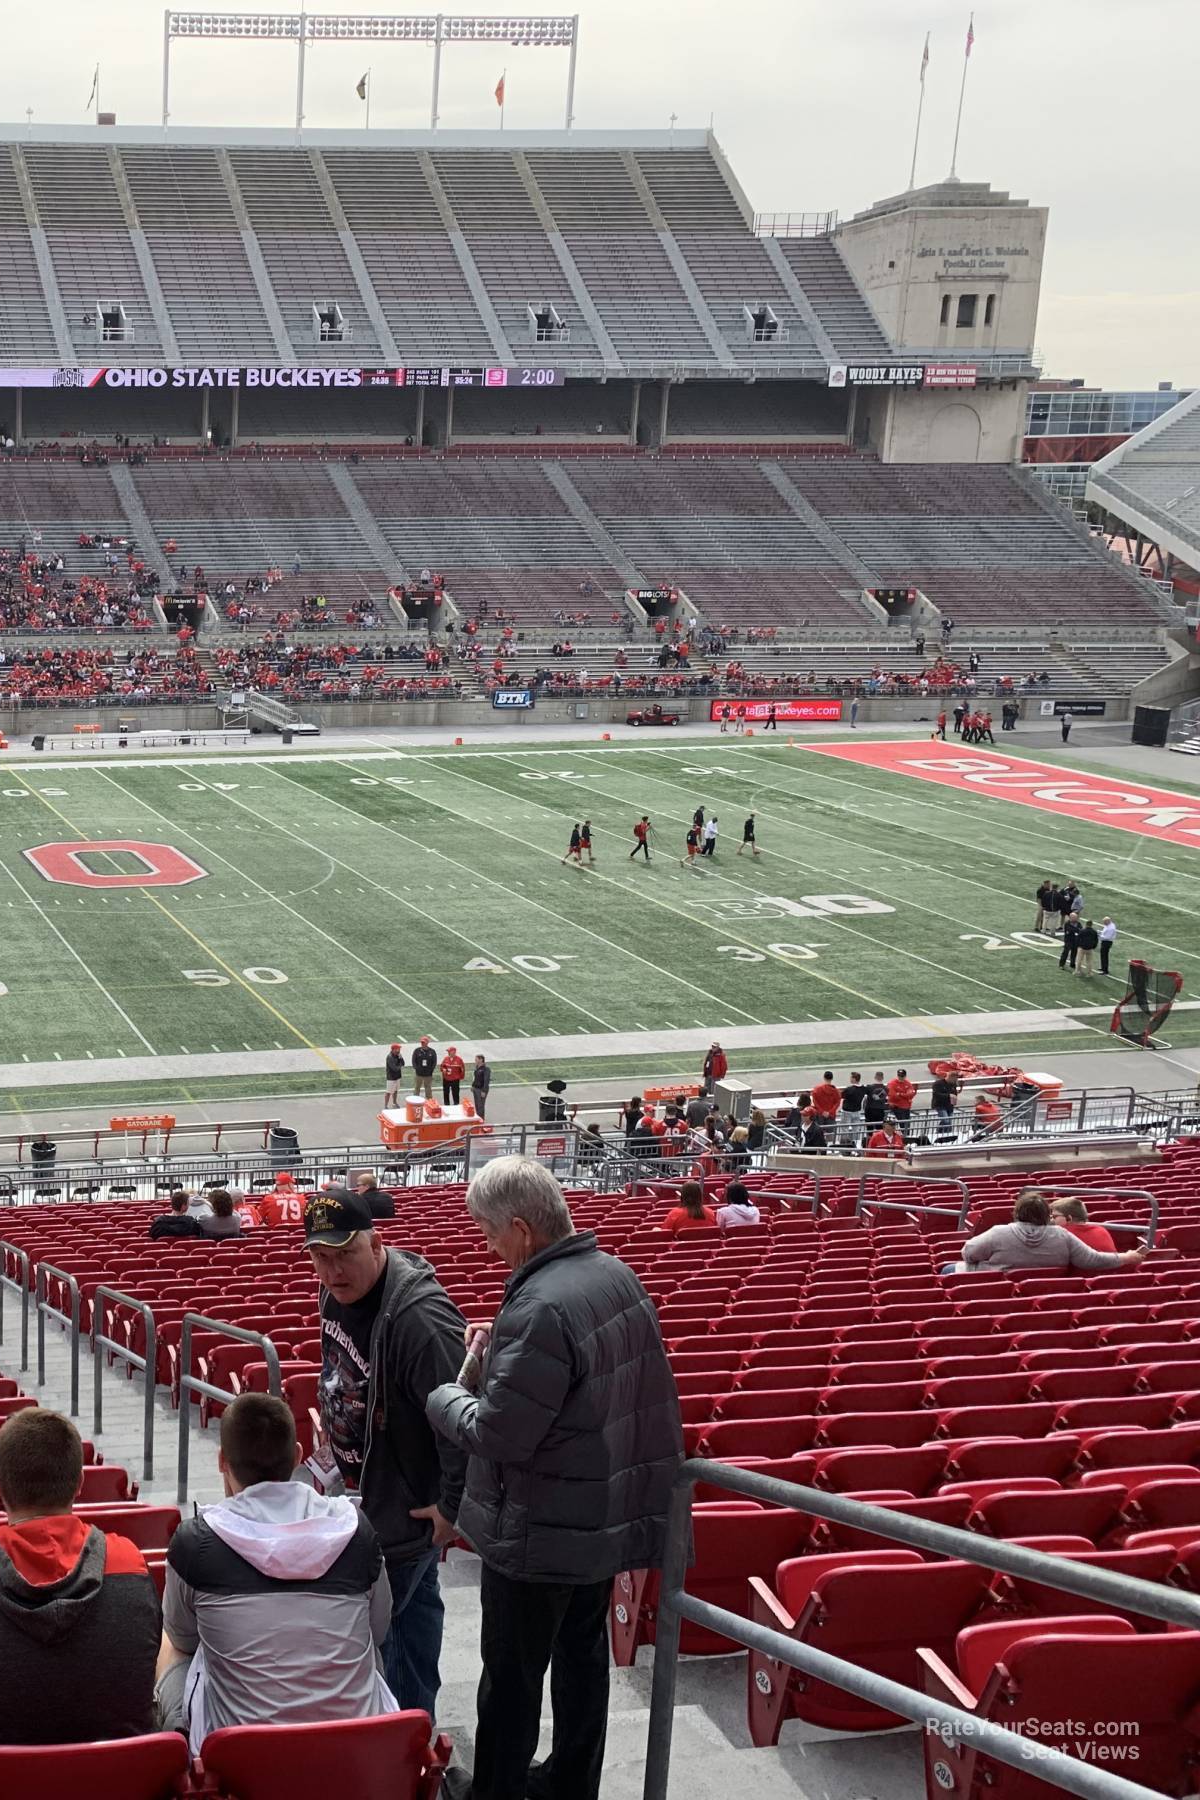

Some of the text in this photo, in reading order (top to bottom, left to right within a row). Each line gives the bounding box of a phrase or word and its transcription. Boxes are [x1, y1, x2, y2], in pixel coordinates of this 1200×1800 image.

[943, 259, 1005, 268] Football Center
[105, 368, 362, 387] OHIO STATE BUCKEYES
[521, 369, 555, 384] 2:00
[849, 367, 923, 380] WOODY HAYES
[497, 693, 526, 704] BTN
[896, 758, 1200, 839] BUCK
[661, 1089, 692, 1097] GATORADE
[126, 1119, 162, 1128] GATORADE
[402, 1128, 419, 1147] G
[276, 1199, 302, 1221] 79
[313, 1197, 342, 1209] ARMY
[936, 1763, 952, 1788] 29A
